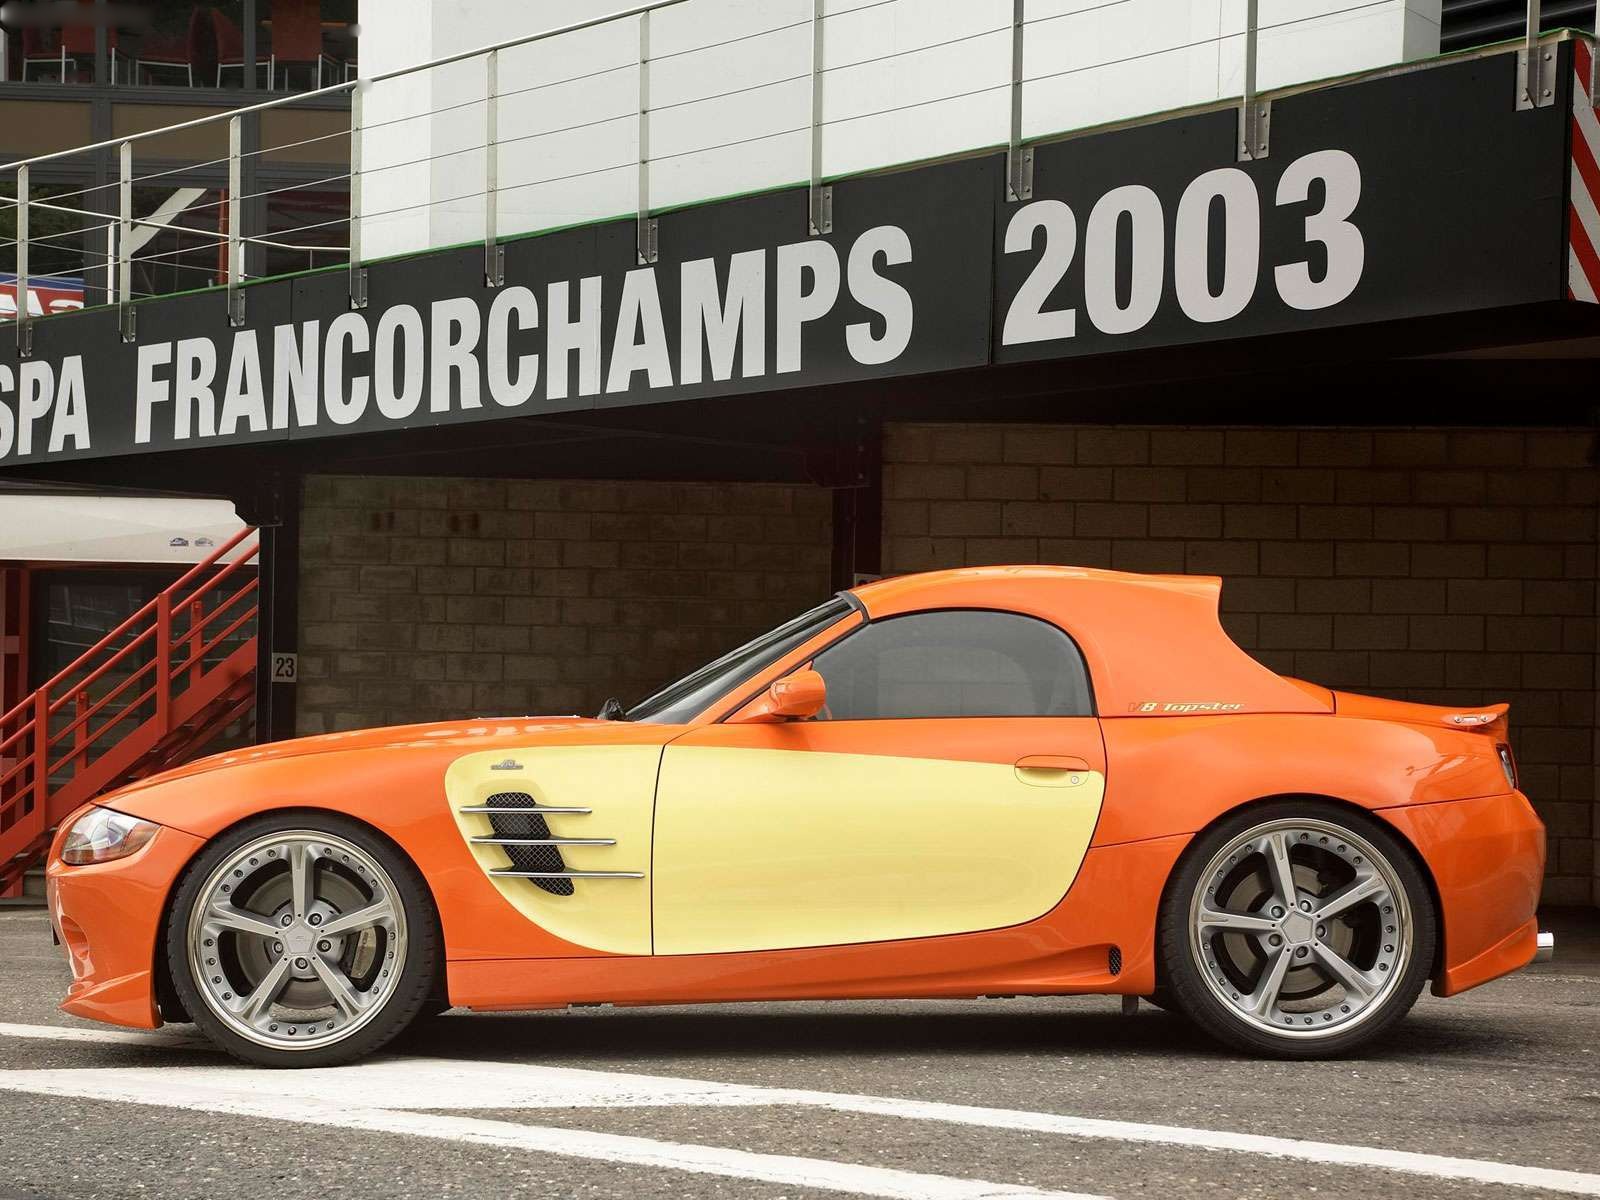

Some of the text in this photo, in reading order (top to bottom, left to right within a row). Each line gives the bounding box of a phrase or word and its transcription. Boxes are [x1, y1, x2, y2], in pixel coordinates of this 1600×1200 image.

[134, 225, 914, 443] FRANCORCHAMPS
[1002, 149, 1365, 346] 2003
[275, 657, 295, 677] 23
[1127, 701, 1245, 713] V8 Topster
